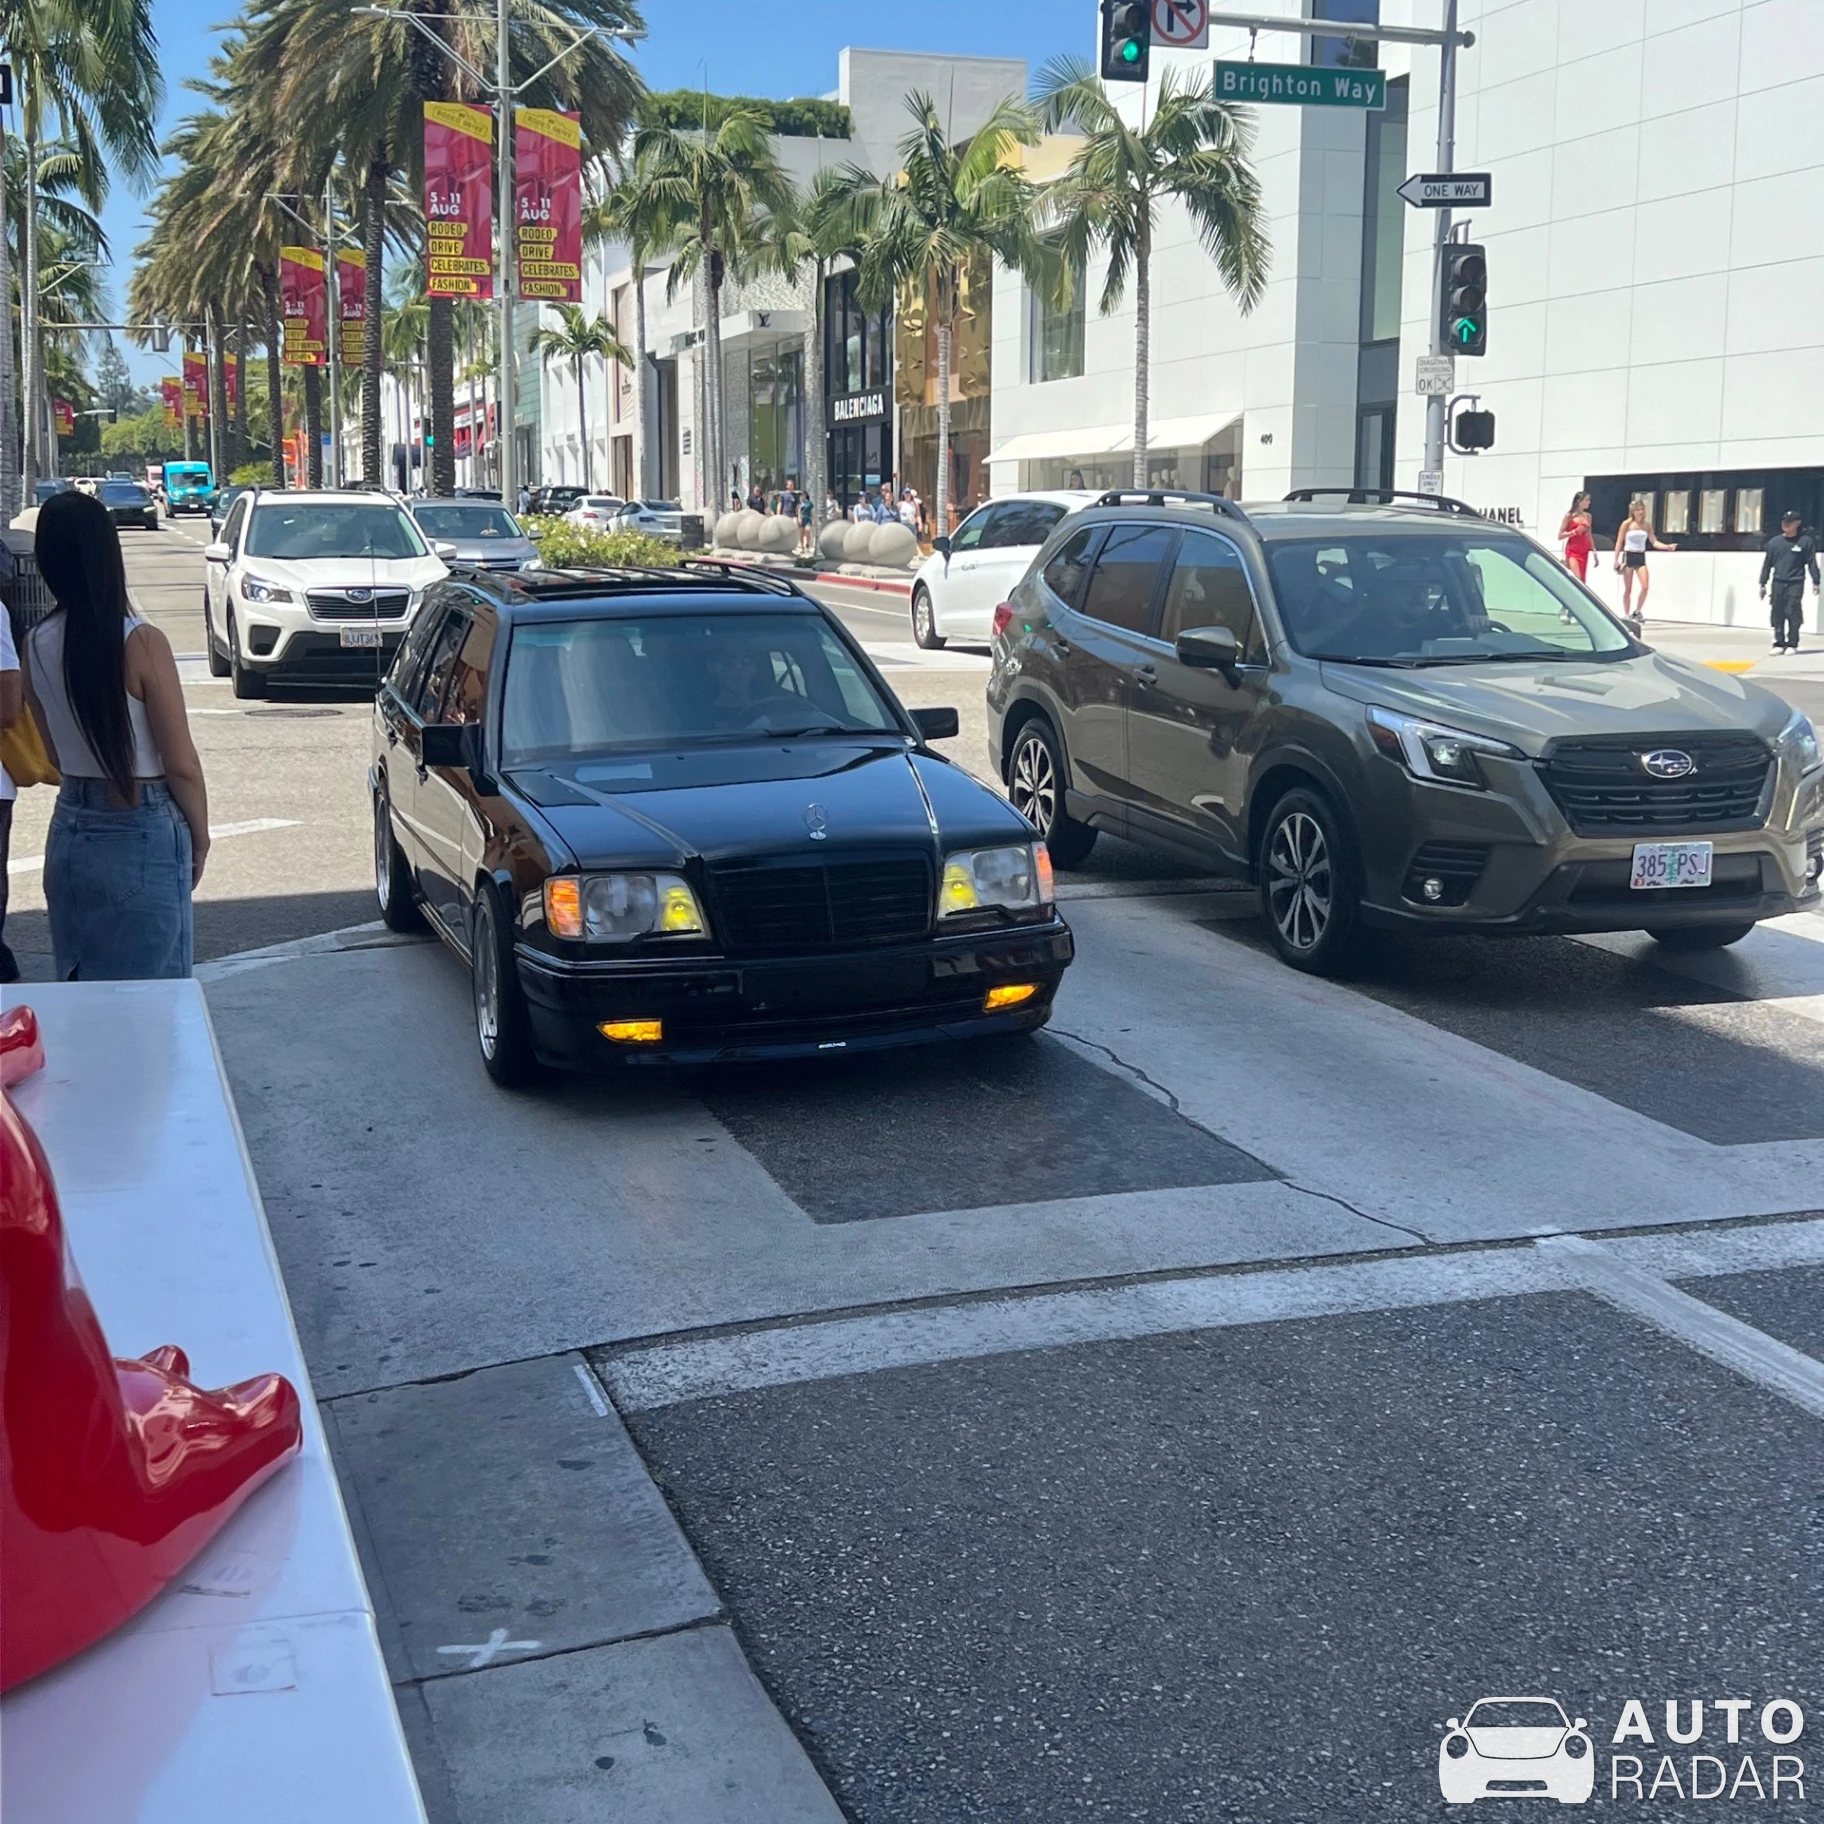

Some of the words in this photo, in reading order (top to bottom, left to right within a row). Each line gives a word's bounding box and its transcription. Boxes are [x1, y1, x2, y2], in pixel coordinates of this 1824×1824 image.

[1223, 70, 1321, 100] Brighton
[1335, 77, 1376, 104] Way
[1424, 184, 1449, 197] ONE
[1454, 183, 1480, 197] WAY
[430, 192, 438, 203] 5
[449, 193, 461, 204] 11
[521, 197, 529, 208] 5
[540, 198, 551, 209] 11
[430, 204, 460, 215] AUG
[521, 209, 550, 220] AUG
[431, 222, 463, 236] RODEO
[521, 228, 553, 240] RODEO
[431, 240, 459, 254] DRIVE
[522, 246, 550, 258] DRIVE
[431, 258, 486, 273] CELEBRATES
[522, 263, 575, 277] CELEBRATES
[431, 278, 471, 291] FASHION
[523, 282, 561, 295] FASHION
[285, 308, 304, 316] AUG
[1418, 378, 1433, 391] OK
[834, 393, 884, 421] BALENCIAGA
[1479, 506, 1524, 523] HANEL
[1636, 853, 1668, 878] 385
[1677, 850, 1709, 876] PSJ
